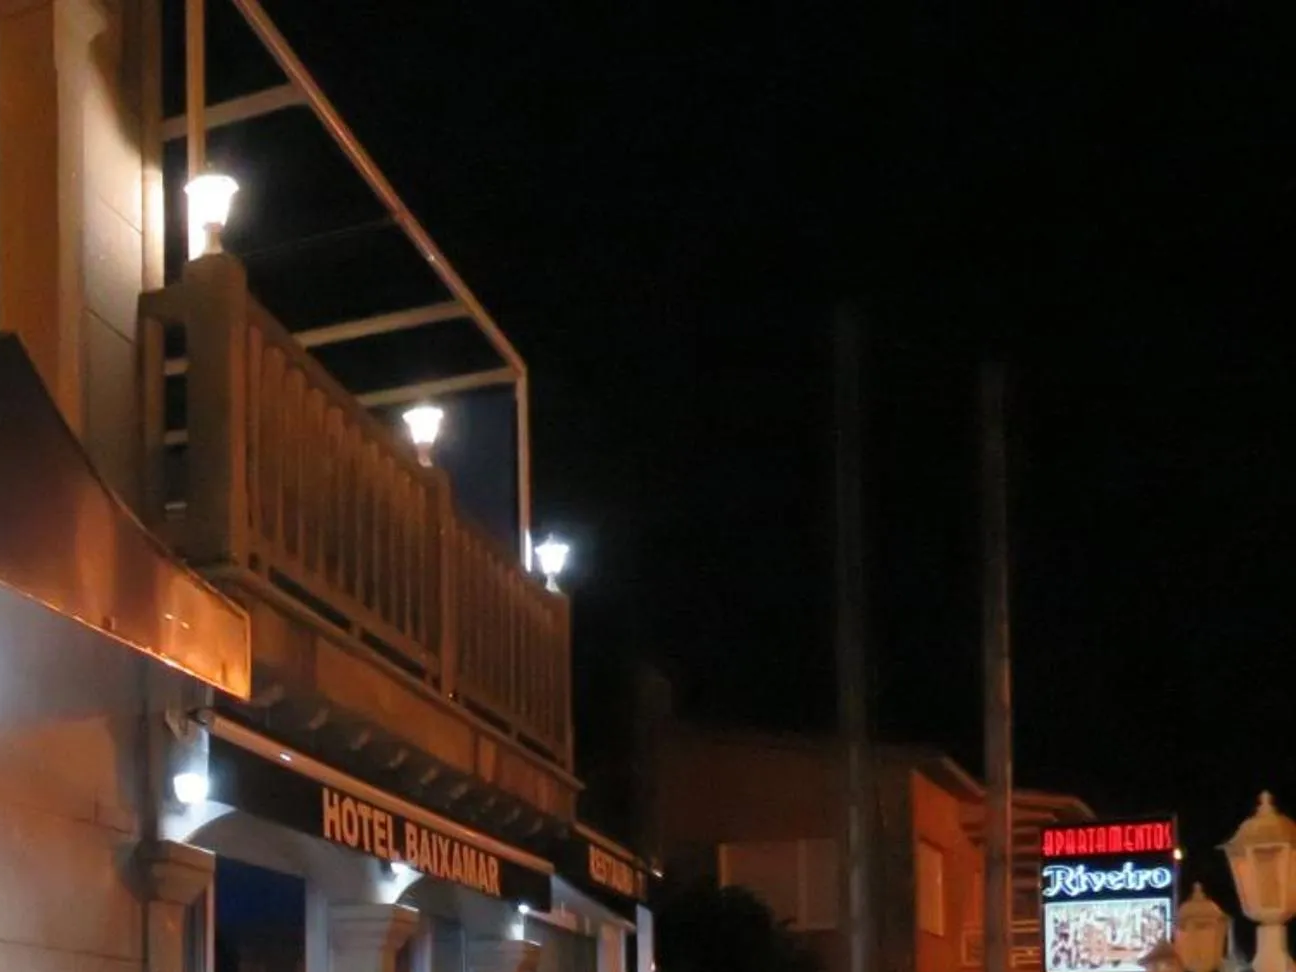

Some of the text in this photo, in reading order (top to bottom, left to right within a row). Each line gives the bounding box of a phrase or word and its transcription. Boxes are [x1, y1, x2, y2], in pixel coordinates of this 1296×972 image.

[321, 787, 501, 897] HOTEL BAIXAMAR
[1043, 823, 1172, 857] APARTAMENTOS
[1042, 862, 1172, 897] Riveiro
